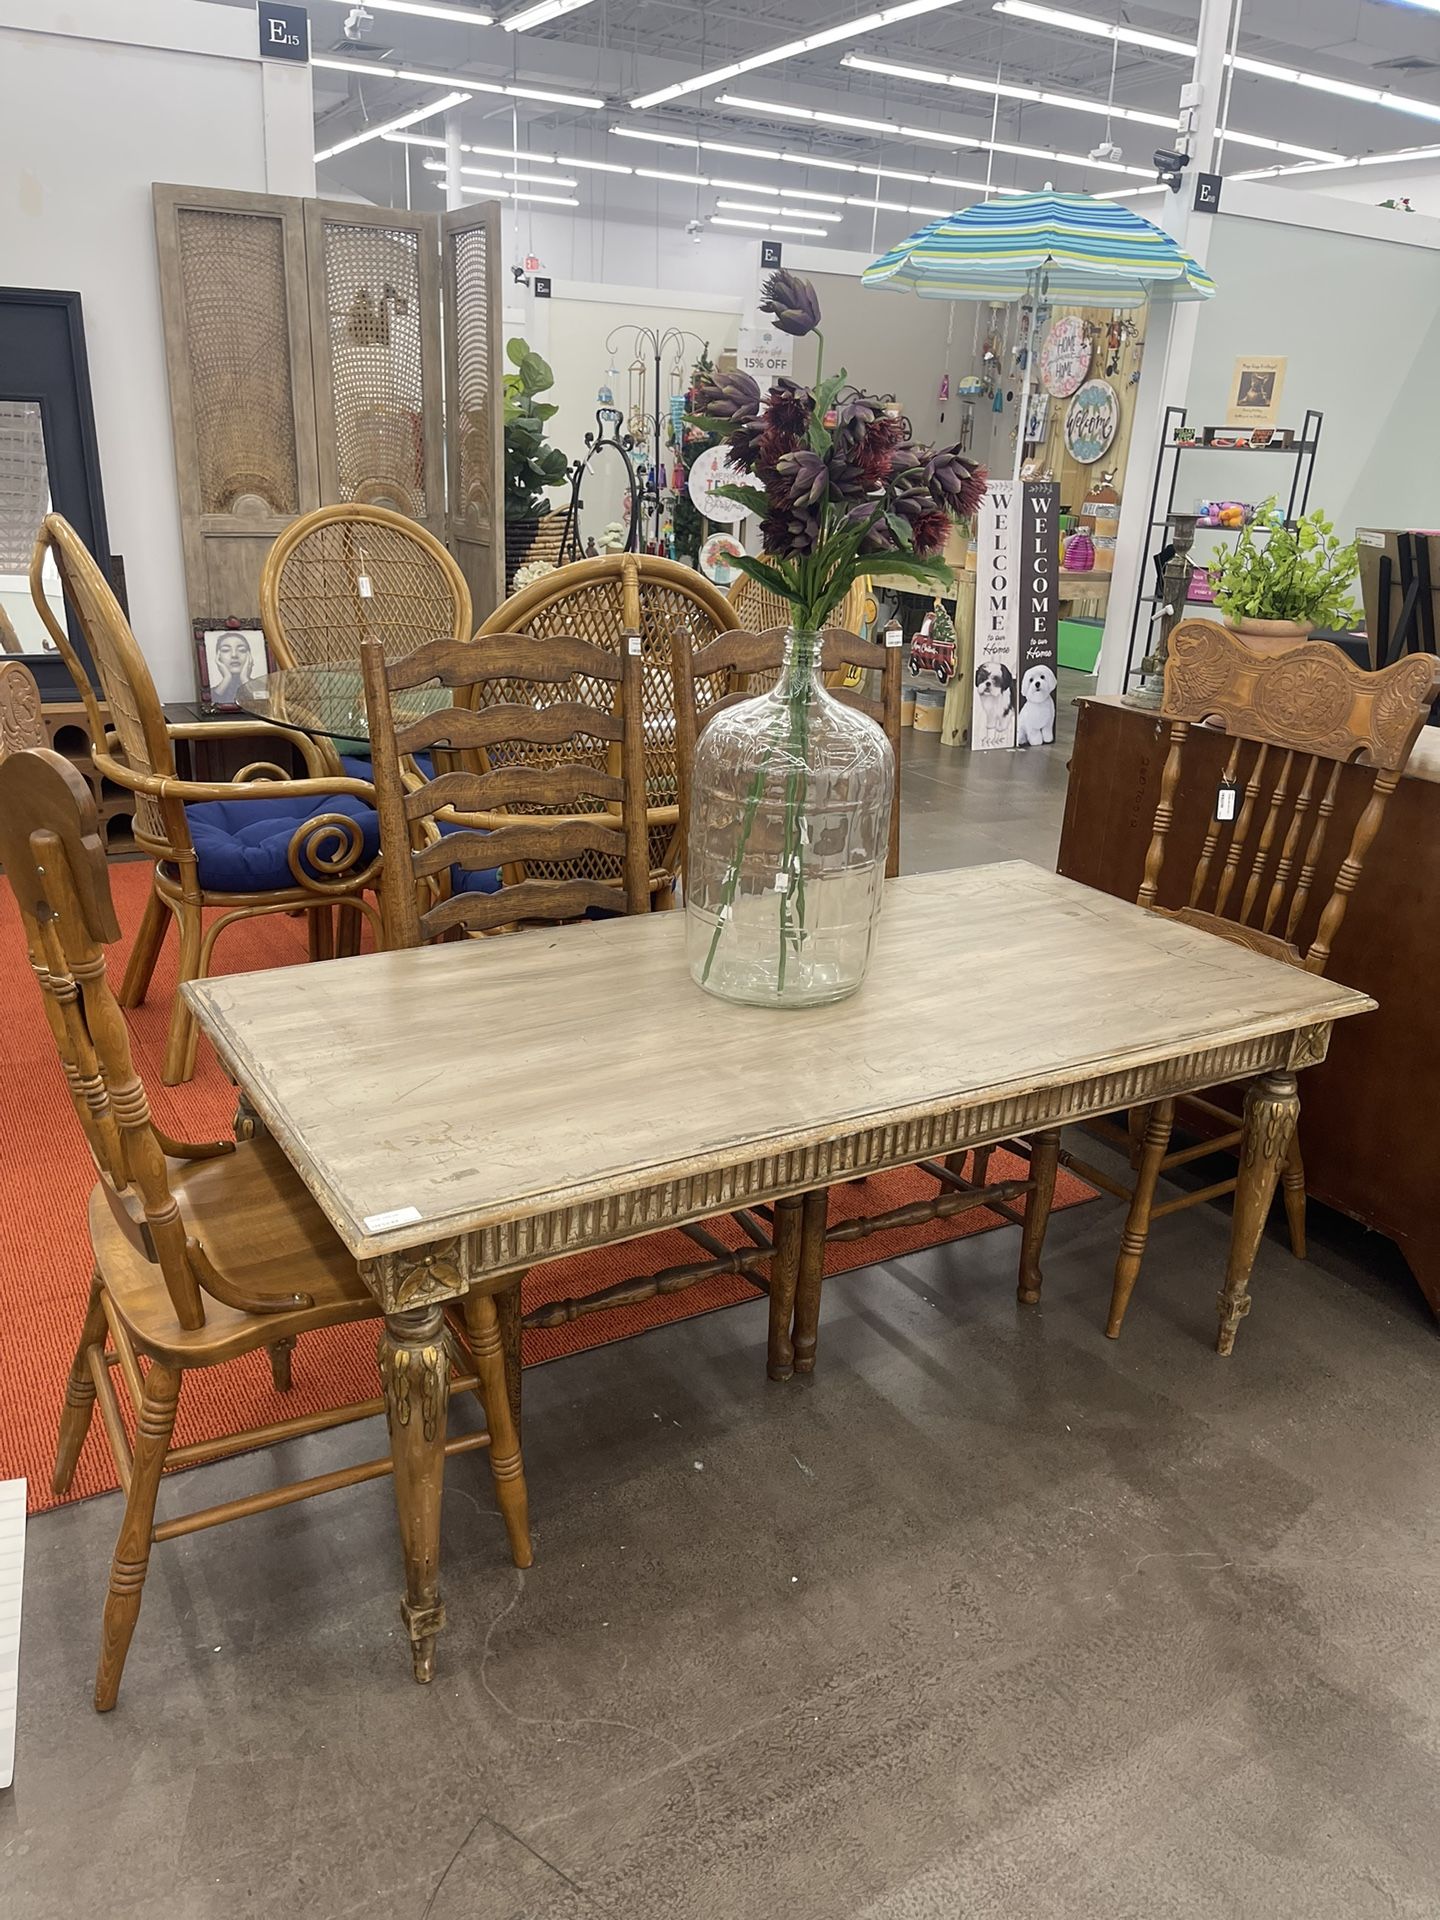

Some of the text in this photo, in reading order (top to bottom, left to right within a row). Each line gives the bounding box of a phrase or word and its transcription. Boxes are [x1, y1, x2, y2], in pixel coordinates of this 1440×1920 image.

[268, 18, 300, 46] E15
[744, 357, 788, 369] 15% OFF
[1066, 409, 1113, 439] Welcome
[989, 493, 1013, 631] WELCOME
[1031, 497, 1051, 633] WELCOME
[982, 642, 1011, 655] Home
[1030, 637, 1037, 646] to
[1026, 646, 1053, 660] Home
